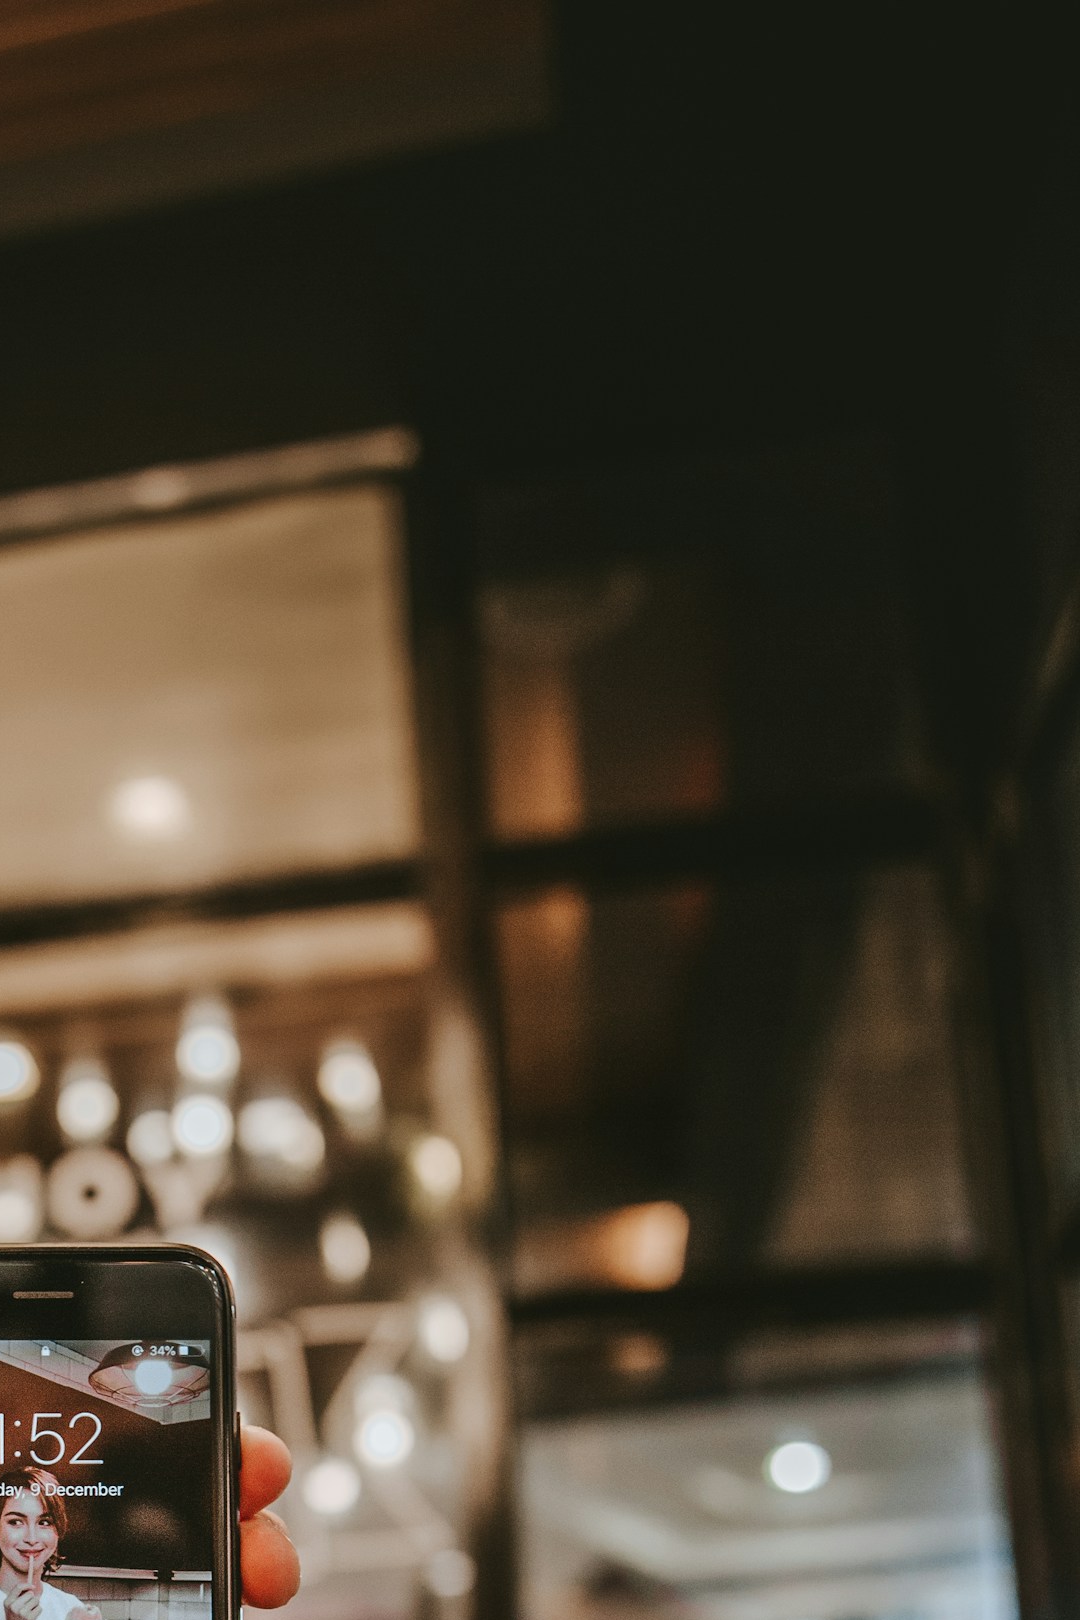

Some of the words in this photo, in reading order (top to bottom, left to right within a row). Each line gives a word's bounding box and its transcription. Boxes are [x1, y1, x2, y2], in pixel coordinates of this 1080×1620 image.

[149, 1345, 176, 1357] 34%
[30, 1482, 40, 1497] 9
[45, 1482, 124, 1497] December
